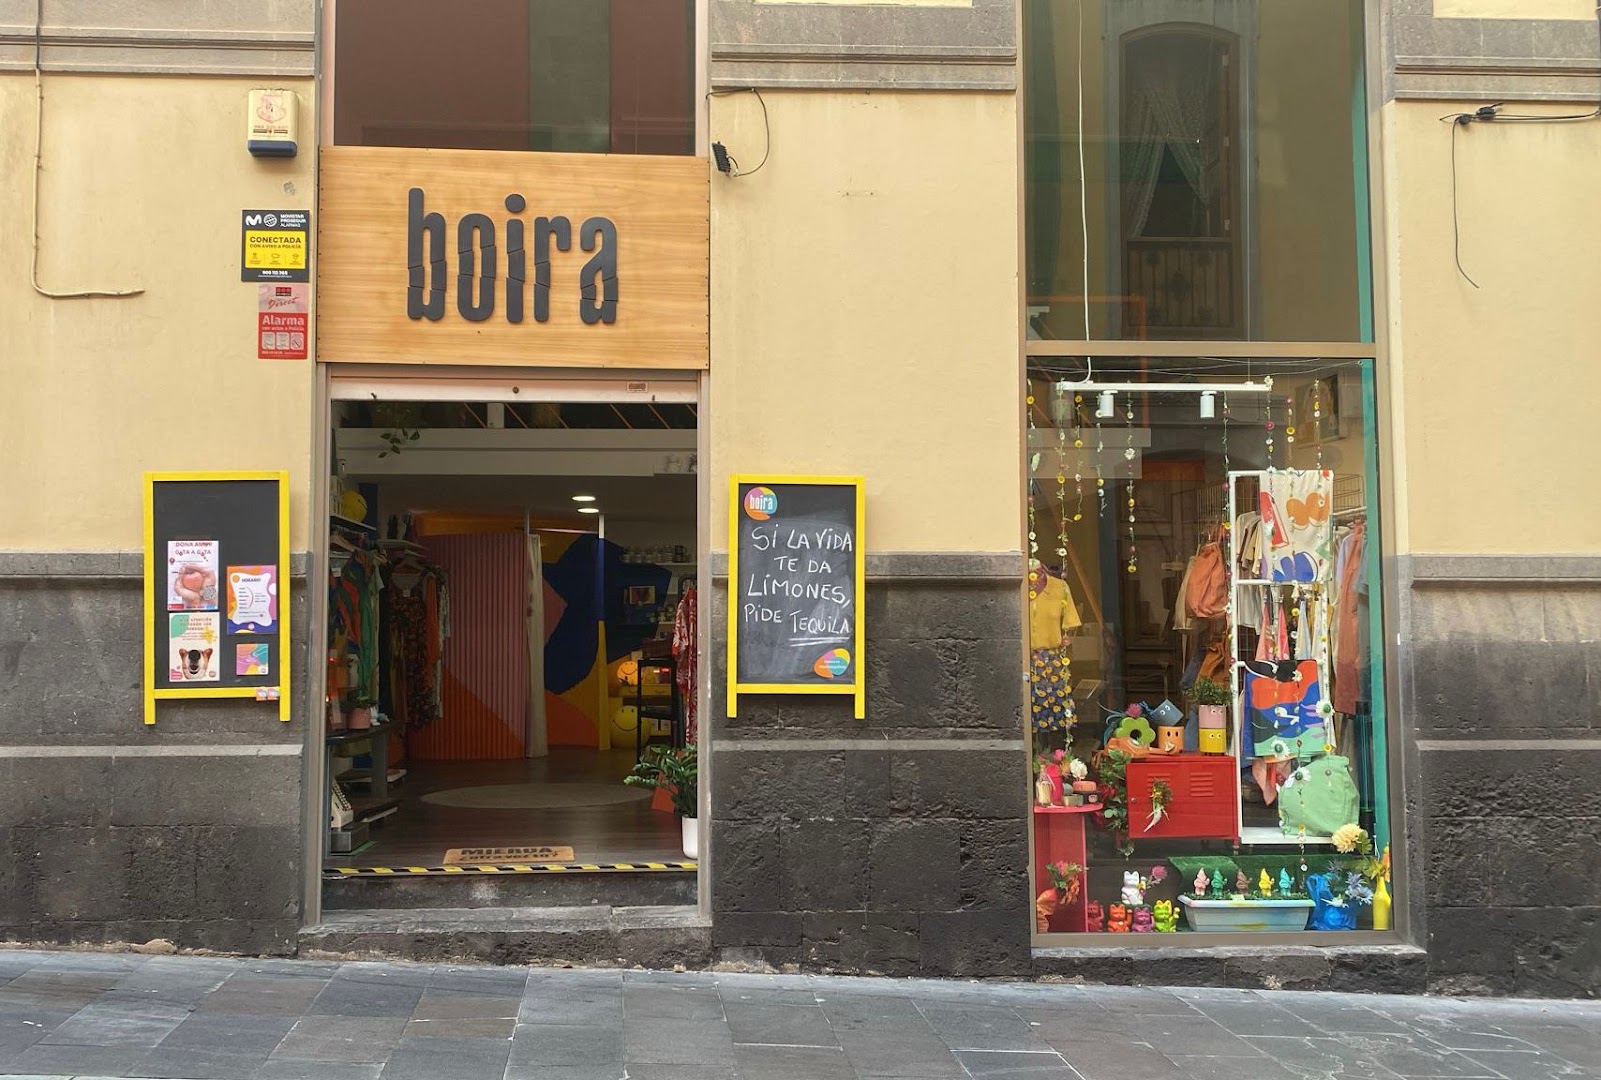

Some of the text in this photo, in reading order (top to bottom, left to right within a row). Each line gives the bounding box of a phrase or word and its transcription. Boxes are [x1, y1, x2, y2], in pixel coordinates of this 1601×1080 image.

[407, 187, 619, 325] boira
[262, 315, 304, 325] Alarma
[749, 494, 773, 510] boira
[787, 529, 810, 549] LA
[773, 556, 832, 573] TE DA
